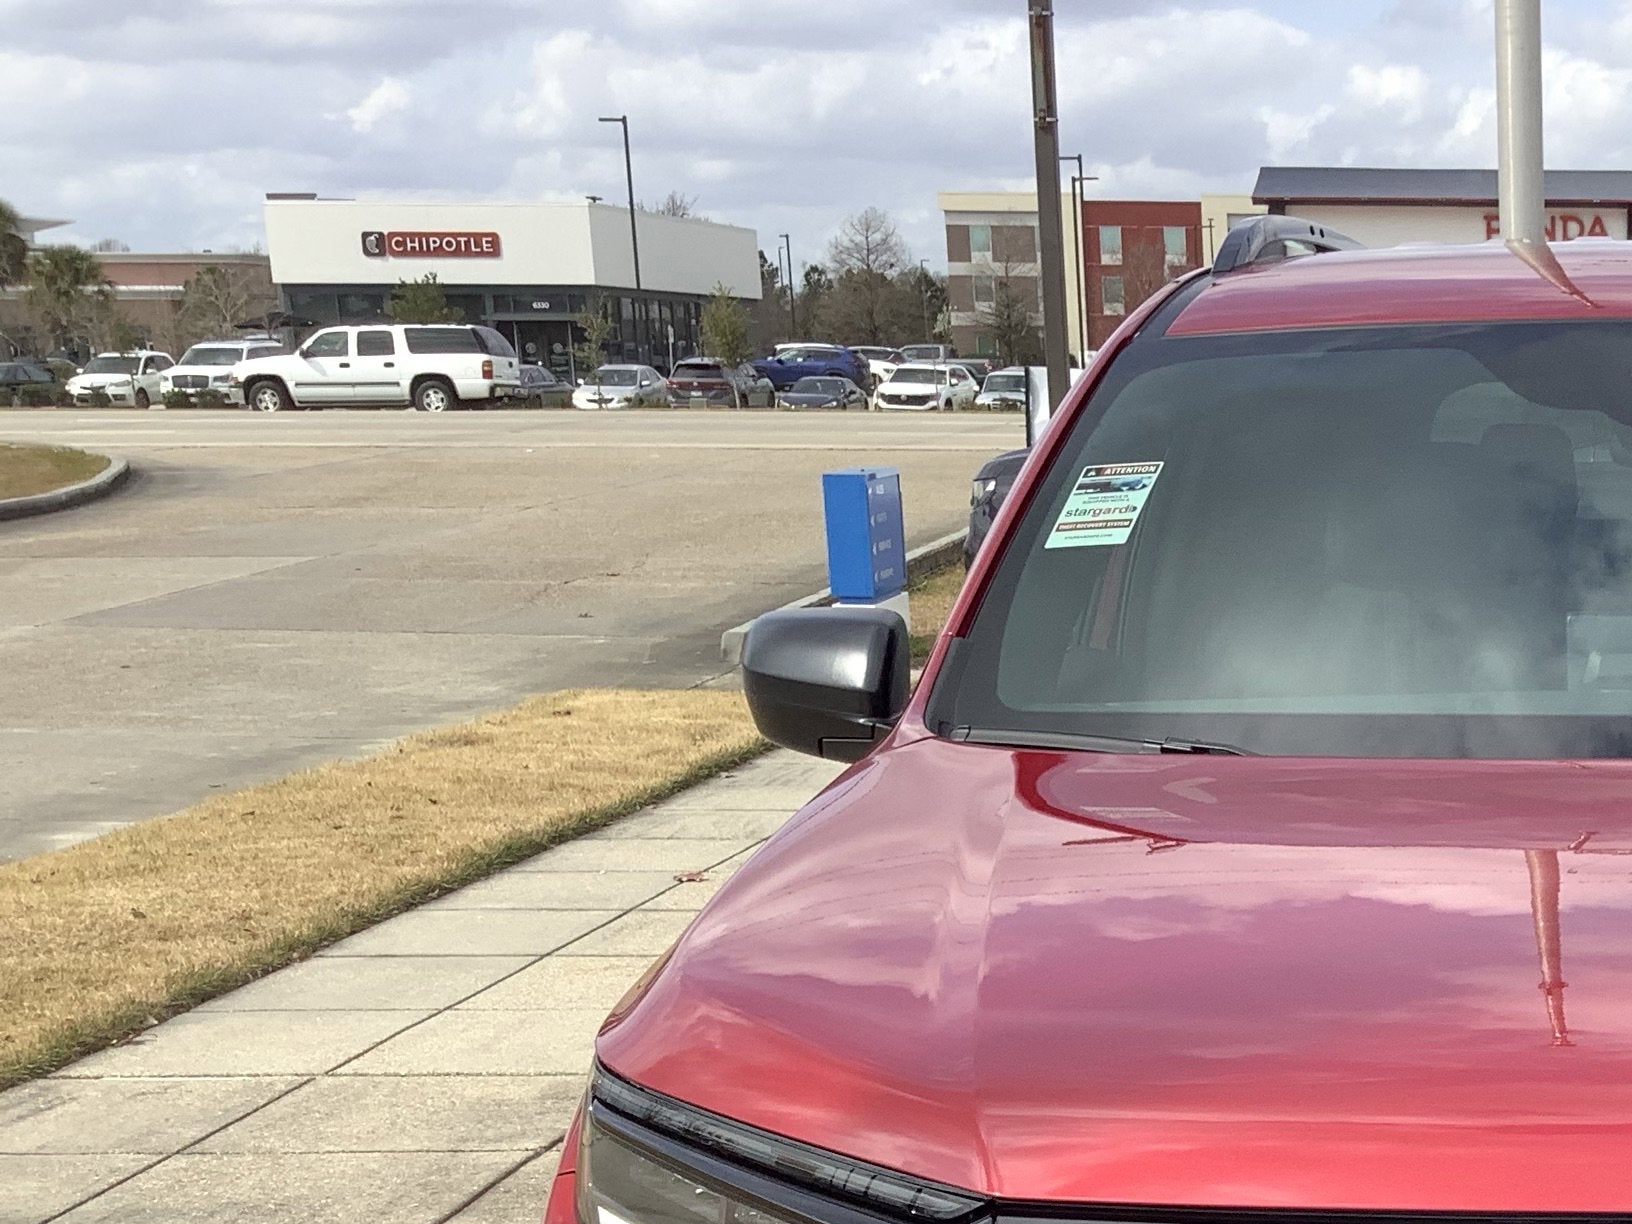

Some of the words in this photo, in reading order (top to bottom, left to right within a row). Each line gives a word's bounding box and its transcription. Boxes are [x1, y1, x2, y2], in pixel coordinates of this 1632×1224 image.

[391, 236, 494, 252] CHIPOTLE
[1103, 465, 1157, 475] ATTENTION
[1076, 521, 1107, 529] RECOVERY
